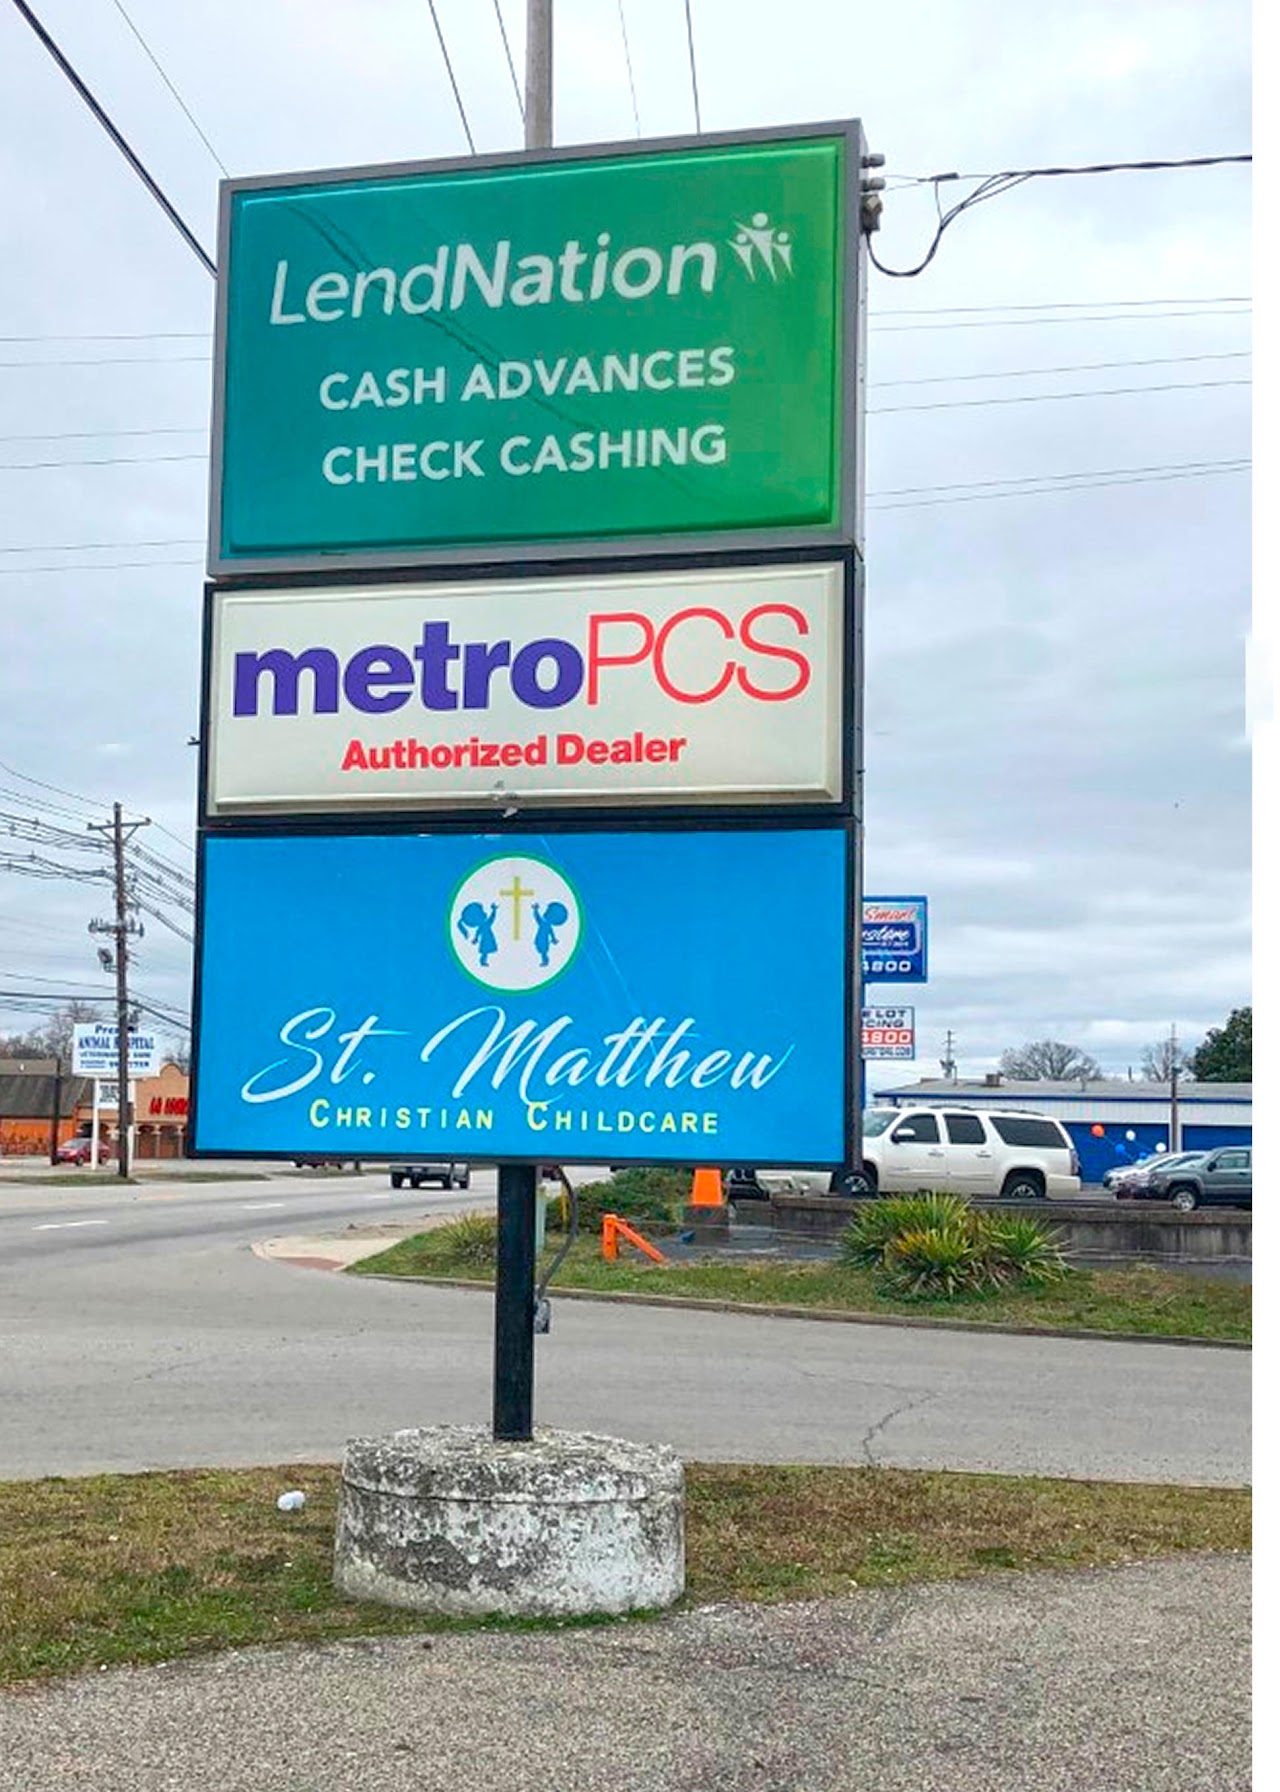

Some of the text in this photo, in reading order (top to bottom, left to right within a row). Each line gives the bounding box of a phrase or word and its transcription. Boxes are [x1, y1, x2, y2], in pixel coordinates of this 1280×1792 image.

[270, 232, 718, 326] LendNation
[319, 346, 735, 411] CASH ADVANCES
[322, 423, 727, 486] CHECK CASHING
[232, 603, 812, 718] metroPCS
[341, 731, 687, 771] Authorized Dealer
[241, 1004, 796, 1107] St. Matthew
[309, 1098, 718, 1134] CHRISTIAN CHILDCARE
